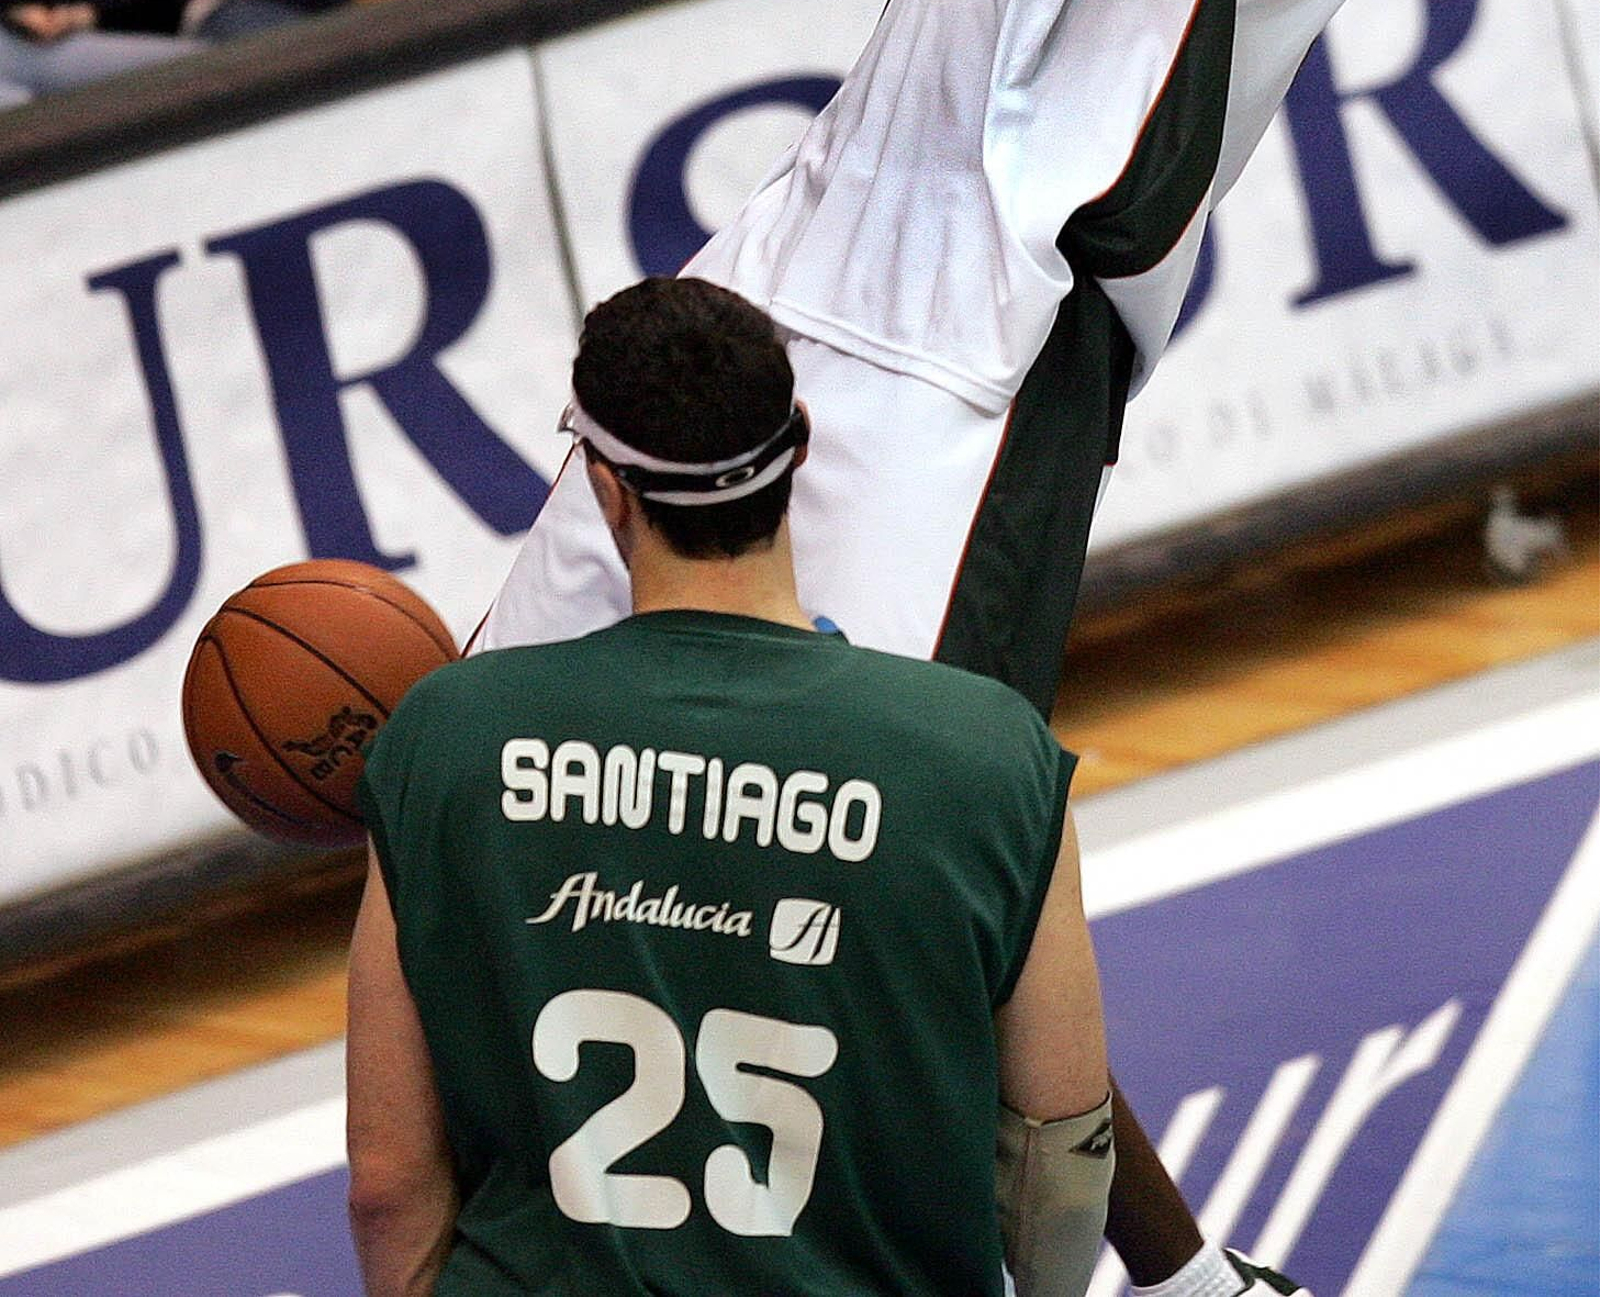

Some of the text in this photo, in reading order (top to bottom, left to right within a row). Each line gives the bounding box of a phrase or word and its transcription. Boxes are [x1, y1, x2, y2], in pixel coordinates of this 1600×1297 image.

[0, 725, 160, 811] DICO
[500, 737, 882, 863] SANTIAGO
[531, 988, 839, 1238] 25
